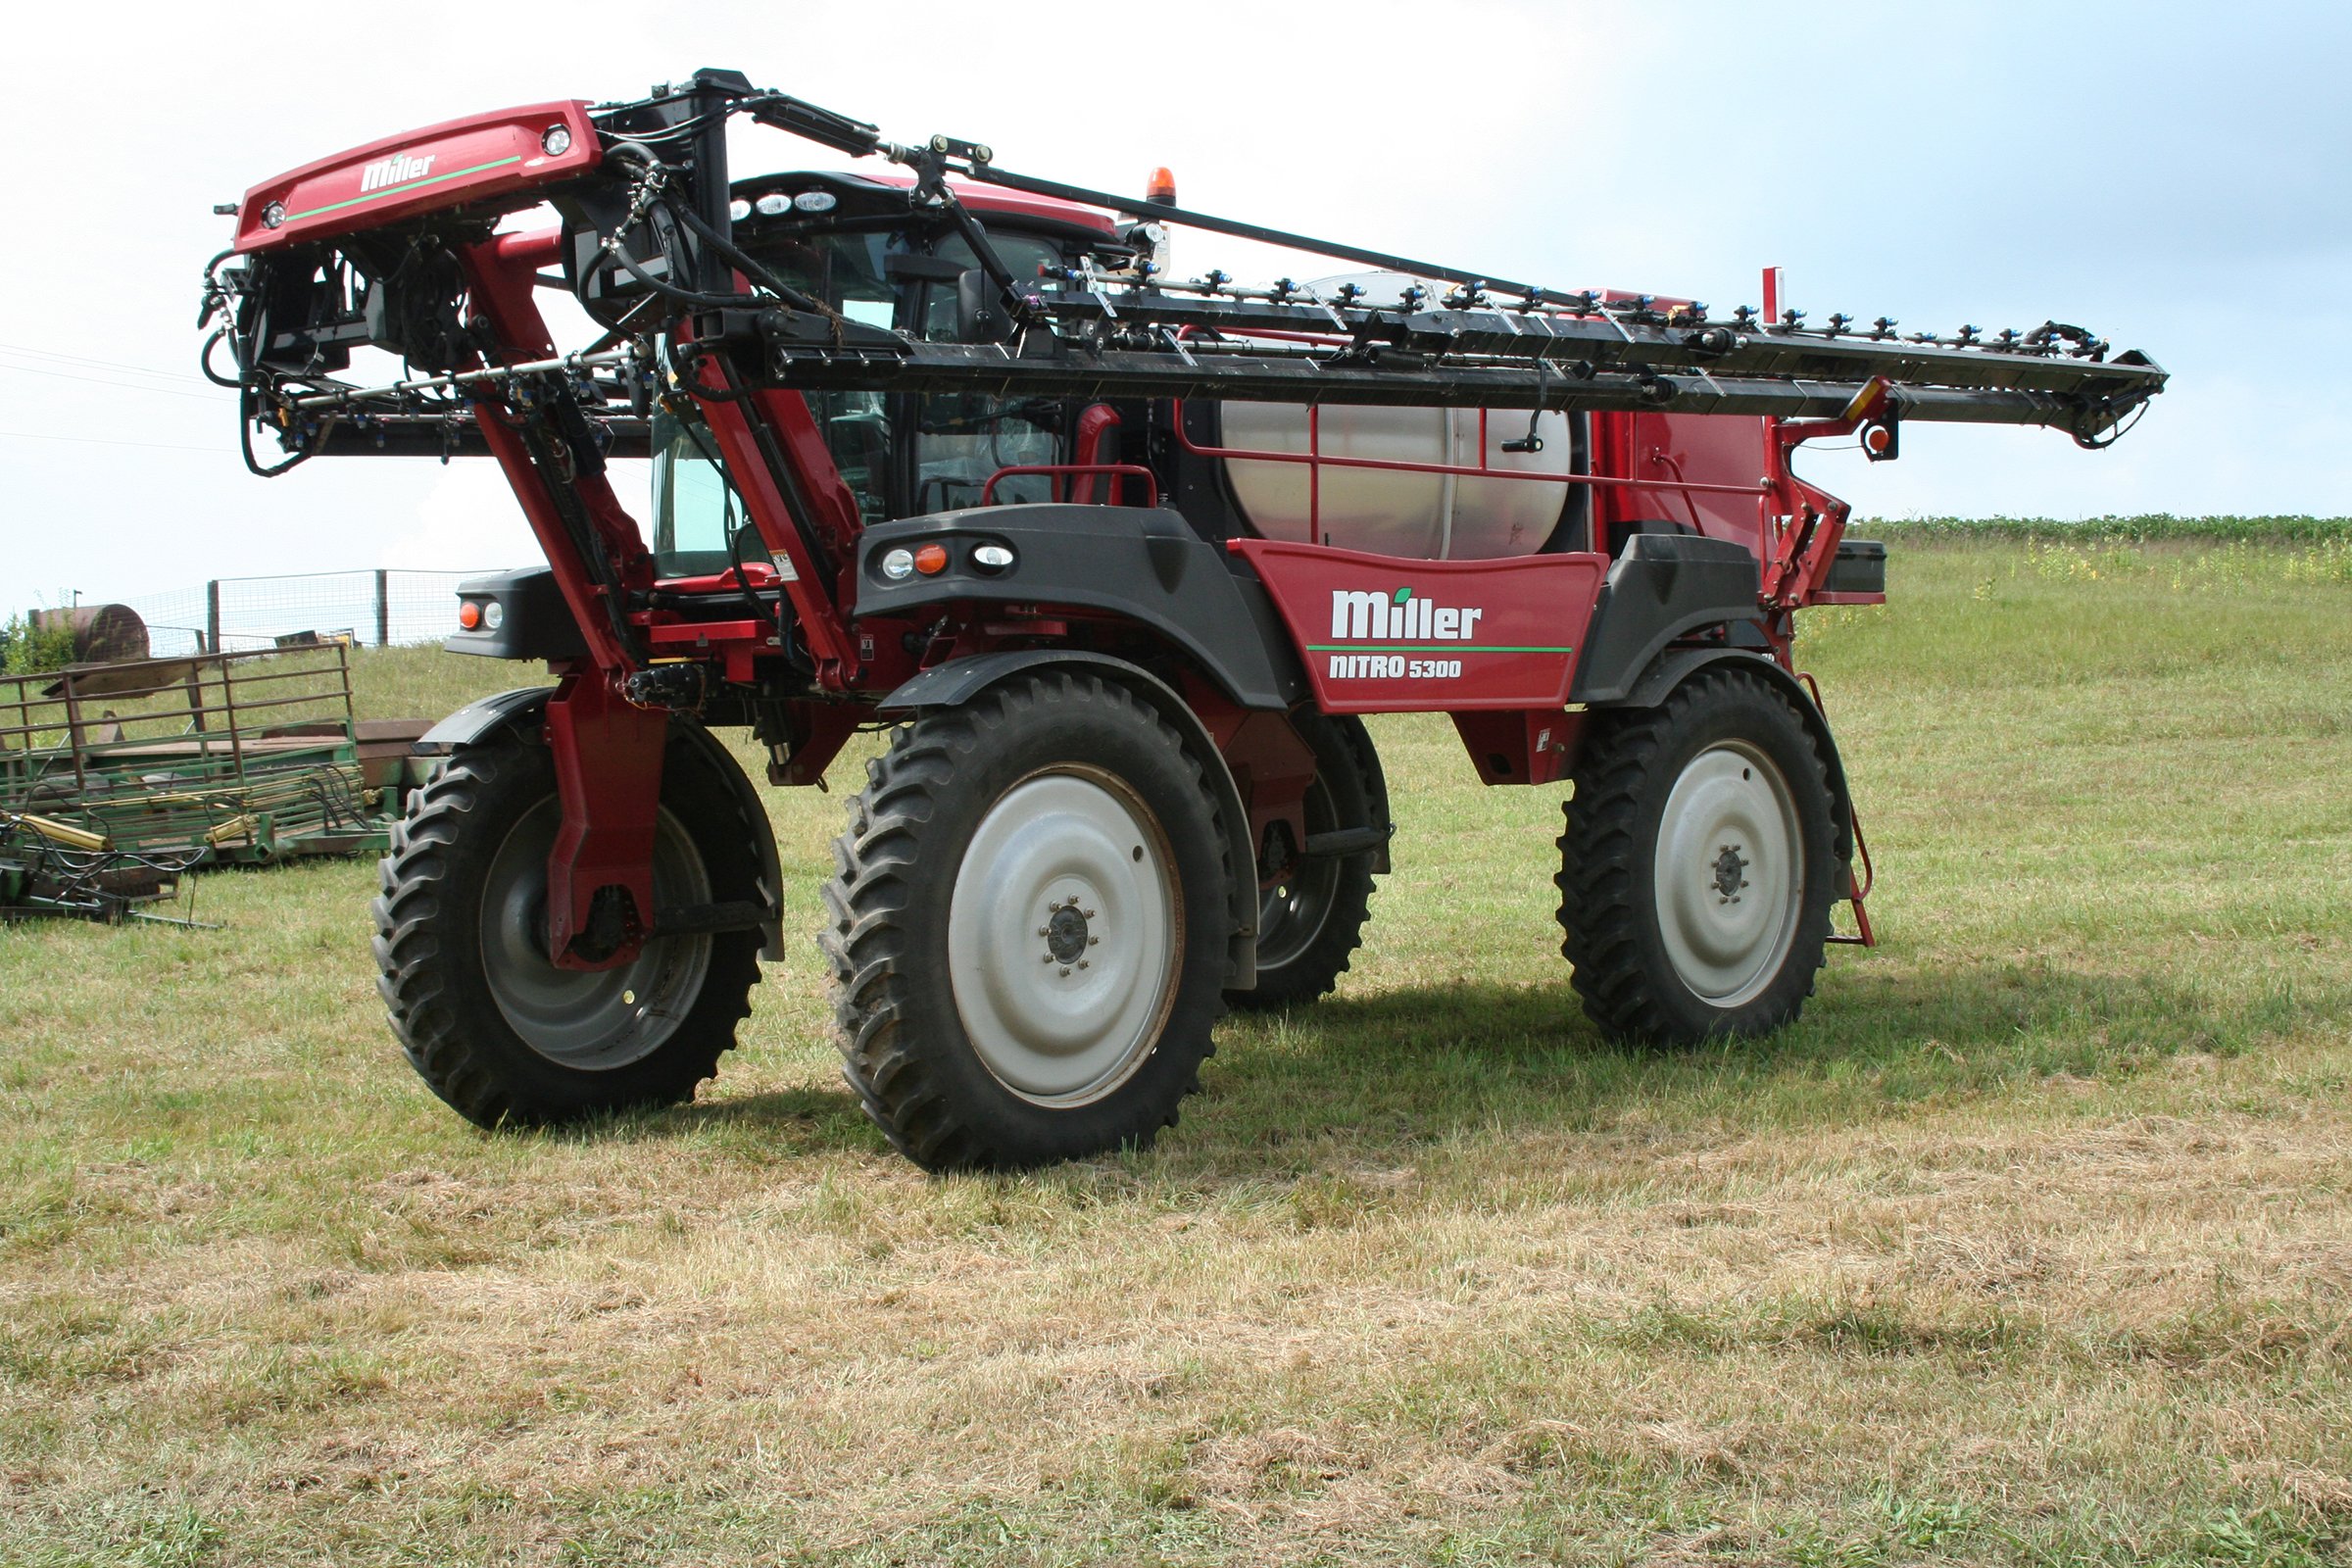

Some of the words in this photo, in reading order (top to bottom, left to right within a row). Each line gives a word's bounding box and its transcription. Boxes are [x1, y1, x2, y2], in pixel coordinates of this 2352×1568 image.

[361, 155, 435, 192] Miller
[1332, 588, 1483, 640] Miller
[1329, 656, 1405, 678] NITRO
[1409, 661, 1462, 678] 5300
